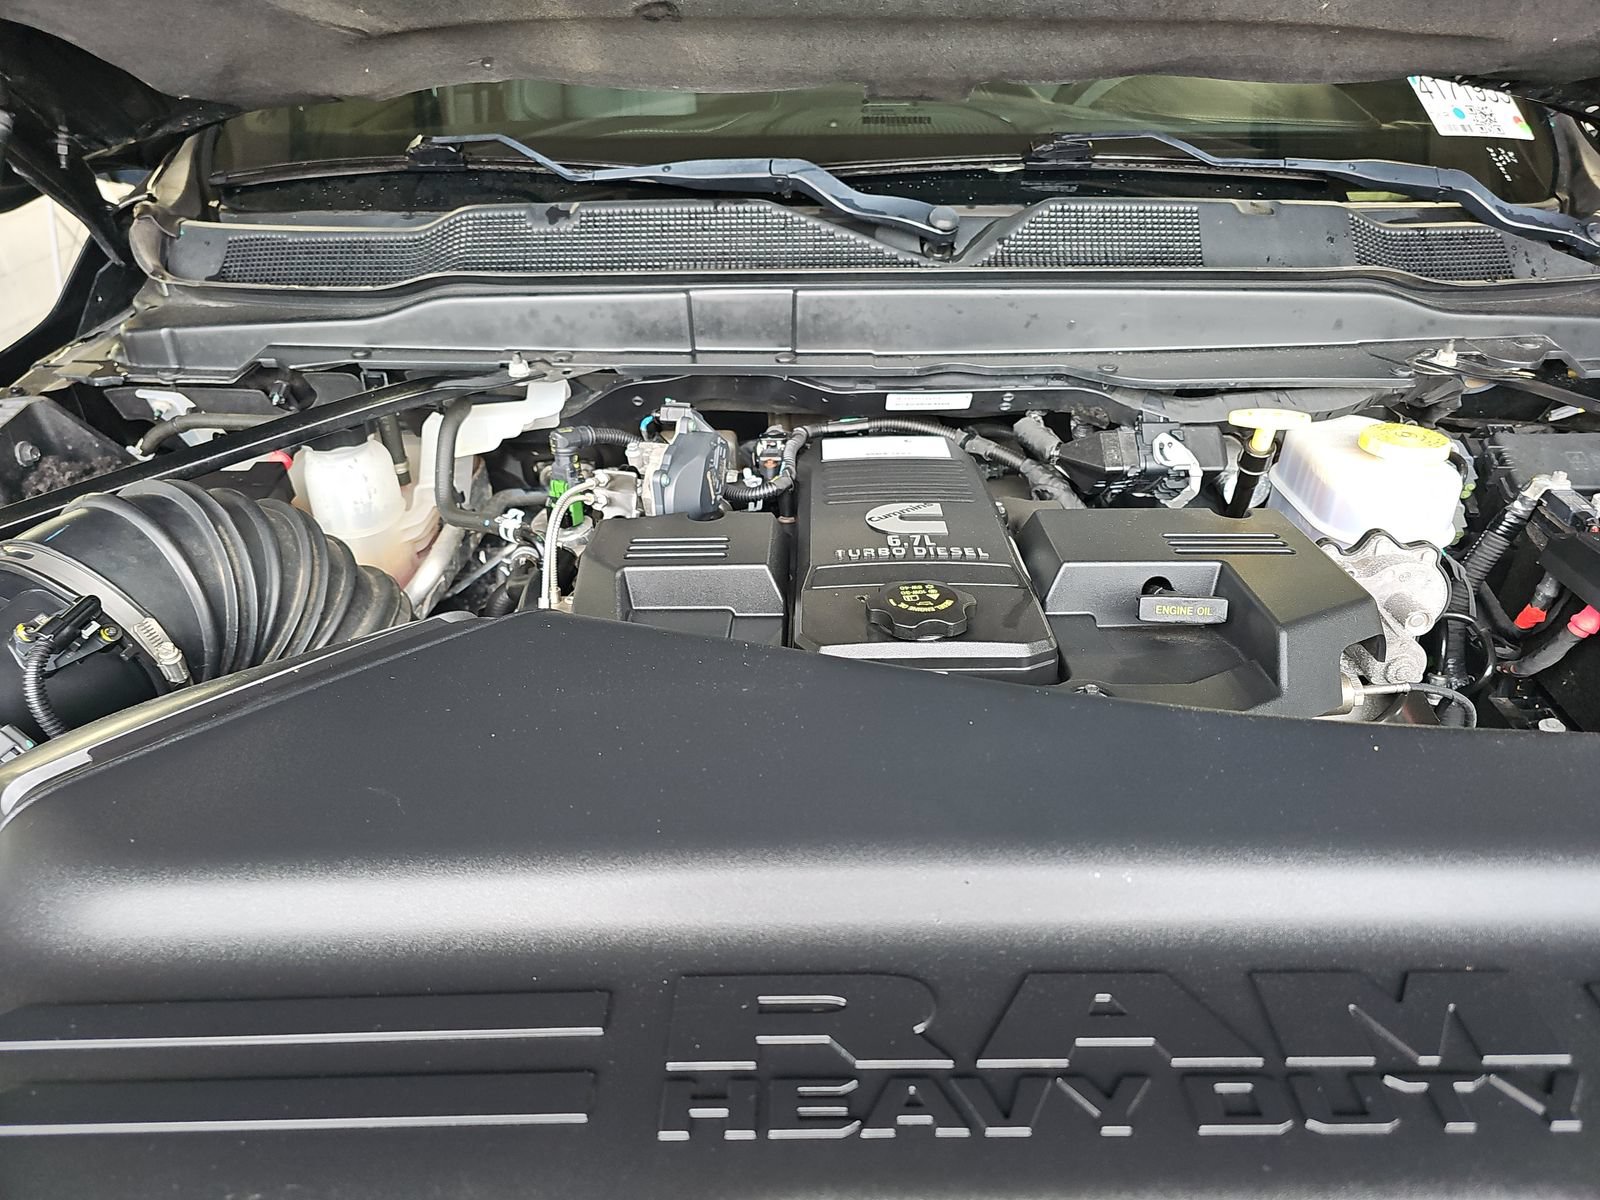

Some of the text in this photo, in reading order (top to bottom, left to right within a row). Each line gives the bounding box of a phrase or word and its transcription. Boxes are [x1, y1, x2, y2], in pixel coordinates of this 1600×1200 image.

[868, 502, 935, 523] Cummins
[887, 534, 936, 547] 6.7L
[835, 547, 990, 560] TURBO DIESEL
[1155, 605, 1213, 616] ENGINE OIL
[665, 968, 1573, 1072] RAM
[657, 1070, 1584, 1142] HEAVY DUTY
